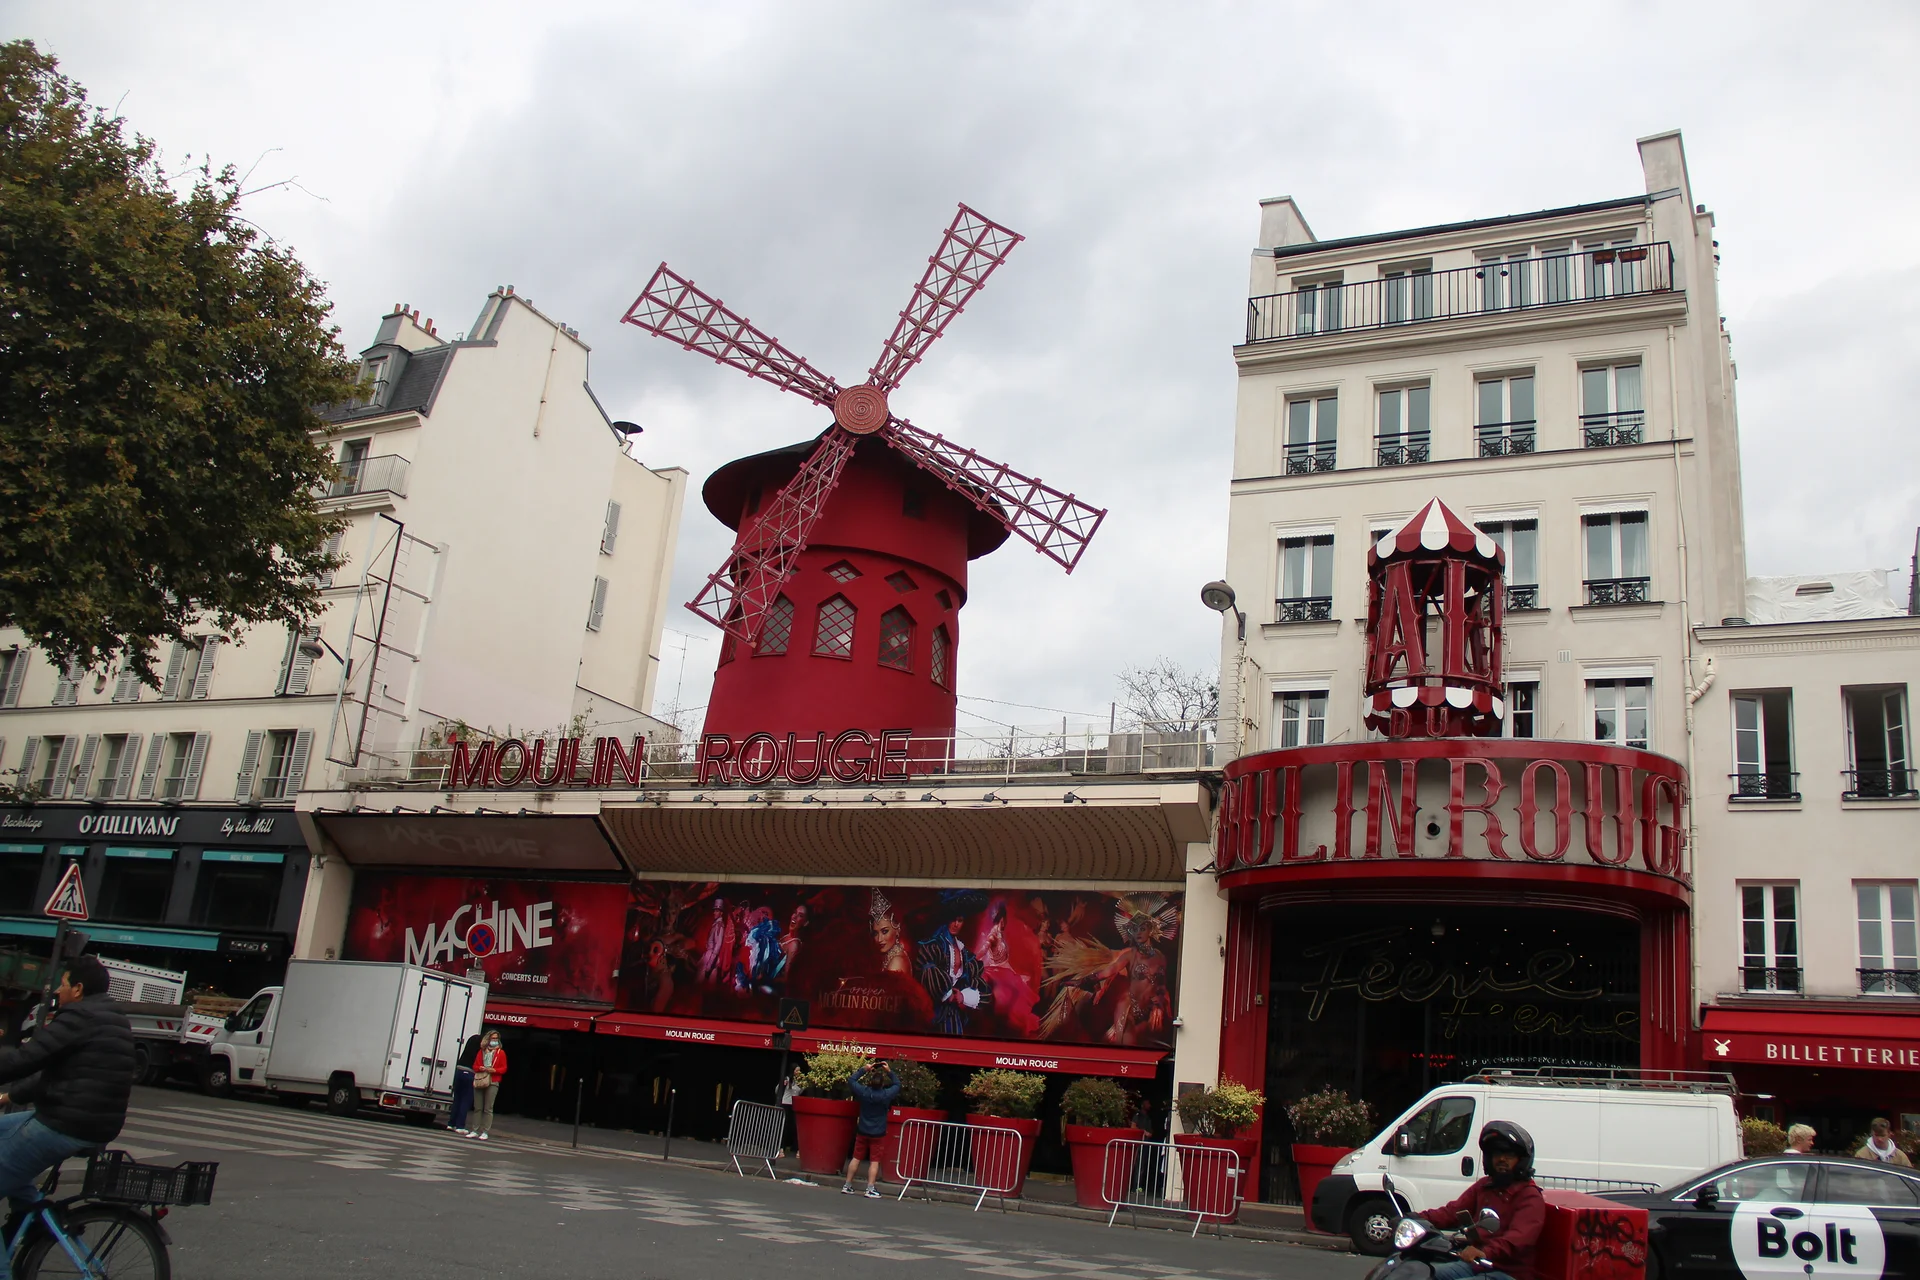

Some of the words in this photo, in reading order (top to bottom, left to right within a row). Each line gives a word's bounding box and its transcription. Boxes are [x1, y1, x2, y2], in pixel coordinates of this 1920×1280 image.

[1367, 556, 1494, 684] AL
[1391, 707, 1449, 738] DU
[447, 735, 645, 788] MOULIN
[699, 728, 913, 784] ROUGE
[2, 814, 43, 833] Backstage
[79, 815, 181, 836] O'SULLIVANS
[1216, 757, 1421, 874] OULIN
[220, 817, 235, 837] By
[235, 818, 251, 833] the
[250, 818, 275, 833] Mill
[405, 900, 553, 967] MACHINE
[501, 972, 532, 983] CONCERTS
[532, 974, 549, 984] CLUB
[832, 976, 886, 997] Forever
[817, 991, 860, 1009] MOULIN
[861, 995, 901, 1013] ROUGE
[484, 1012, 507, 1023] MOULIN
[507, 1014, 528, 1025] ROUGE
[665, 1030, 691, 1039] MOULIN
[691, 1032, 716, 1041] ROUGE
[820, 1043, 850, 1053] MOULIN
[850, 1045, 877, 1055] ROUGE
[1766, 1043, 1920, 1066] BILLETTERIE
[995, 1056, 1028, 1067] MOULIN
[1028, 1059, 1059, 1069] ROUGE
[1756, 1217, 1859, 1266] Bolt
